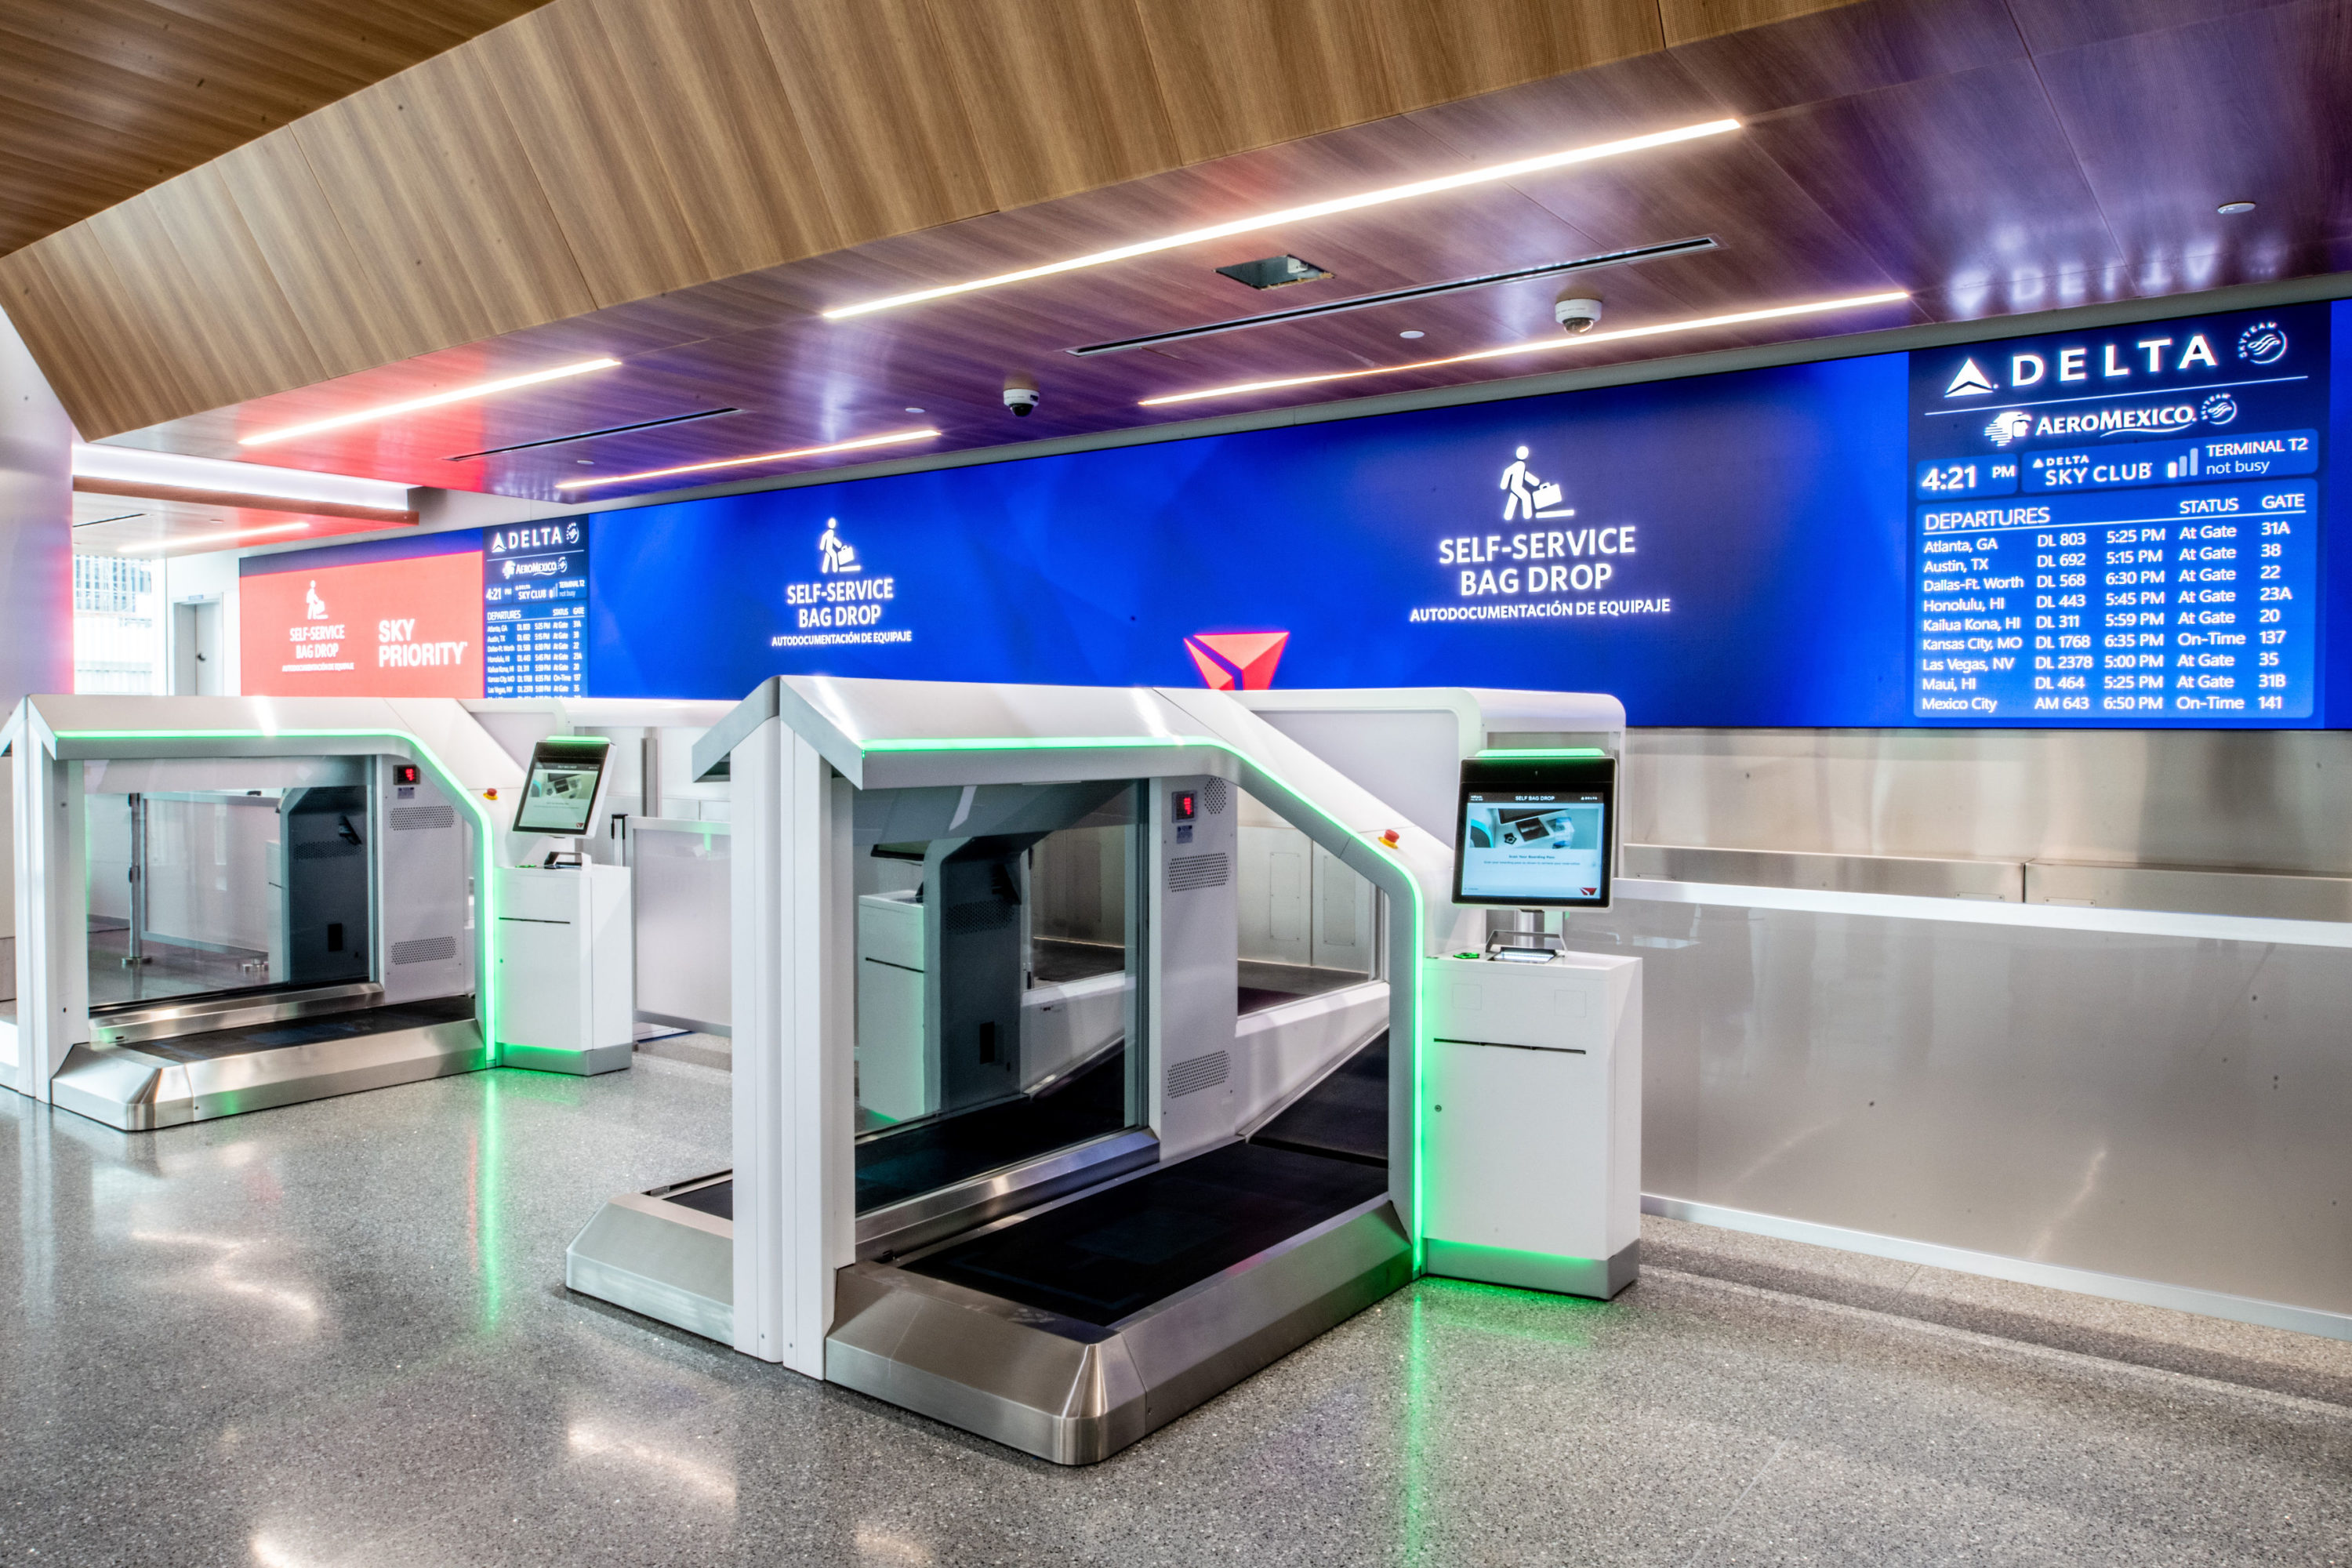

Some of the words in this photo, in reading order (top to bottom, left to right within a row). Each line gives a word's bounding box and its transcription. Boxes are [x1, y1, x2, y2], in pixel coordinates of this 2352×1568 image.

[2012, 335, 2217, 387] DELTA
[2206, 440, 2285, 457] TERMINAL
[2288, 437, 2309, 451] T2
[2046, 455, 2089, 466] DELTA
[2207, 463, 2230, 474] not
[2235, 460, 2270, 474] busy
[1922, 465, 1976, 491] 4:21
[1992, 465, 2016, 478] PM
[2045, 467, 2088, 485] SKY
[2093, 463, 2153, 482] CLUB
[1926, 507, 2050, 531] DEPARTURES
[2180, 498, 2239, 514] STATUS
[2262, 493, 2305, 509] GATE
[508, 527, 562, 549] DELTA
[1439, 525, 1635, 564] SELF-SERVICE
[1924, 540, 1973, 554] Atlanta,
[1976, 538, 1998, 550] GA
[2038, 535, 2056, 547] DL
[2060, 532, 2086, 546] 803
[2107, 529, 2137, 543] 5:25
[2142, 528, 2166, 542] PM
[2180, 527, 2197, 539] At
[2200, 525, 2238, 539] Gate
[2261, 521, 2291, 535] 31A
[1923, 560, 1967, 573] Austin,
[1971, 558, 1989, 571] TX
[2037, 555, 2056, 568] DL
[2060, 553, 2086, 566] 692
[2107, 550, 2134, 564] 5:15
[2139, 550, 2163, 563] PM
[2179, 548, 2197, 561] At
[2200, 546, 2237, 560] Gate
[2261, 543, 2281, 557] 38
[1461, 568, 1519, 596] BAG
[1528, 563, 1613, 593] DROP
[1924, 578, 1980, 592] Dallas-Ft.
[1983, 576, 2024, 590] Worth
[2037, 575, 2056, 588] DL
[2060, 573, 2086, 587] 568
[2106, 572, 2137, 585] 6:30
[2141, 570, 2165, 583] PM
[2179, 569, 2196, 582] At
[2199, 568, 2237, 581] Gate
[2260, 565, 2281, 579] 22
[486, 588, 501, 601] 4:21
[518, 590, 530, 600] SKY
[531, 590, 546, 598] CLUB
[787, 578, 893, 604] SELF-SERVICE
[1924, 597, 1986, 612] Honolulu,
[1990, 597, 2005, 610] HI
[2037, 595, 2056, 608] DL
[2059, 594, 2086, 607] 443
[2106, 592, 2137, 606] 5:45
[2141, 591, 2165, 604] PM
[2178, 590, 2196, 604] At
[2199, 590, 2236, 603] Gate
[2260, 586, 2293, 601] 23A
[488, 610, 521, 620] DEPARTURES
[799, 608, 832, 628] BAG
[836, 604, 881, 626] DROP
[1410, 601, 1573, 622] AUTODOCUMENTACIÓN
[1576, 601, 1595, 615] DE
[1600, 598, 1671, 616] EQUIPAJE
[1923, 619, 1962, 632] Kailua
[1964, 619, 2002, 632] Kona,
[2005, 617, 2021, 630] HI
[2036, 615, 2056, 629] DL
[2059, 615, 2080, 628] 311
[2105, 613, 2137, 627] 5:59
[2140, 612, 2165, 626] PM
[2178, 612, 2196, 624] At
[2198, 611, 2236, 624] Gate
[2259, 608, 2281, 622] 20
[290, 625, 345, 641] SELF-SERVICE
[379, 619, 415, 642] SKY
[771, 631, 860, 646] AUTODOCUMENTACIÓN
[861, 633, 873, 643] DE
[873, 631, 912, 644] EQUIPAJE
[1922, 639, 1965, 651] Kansas
[1967, 637, 1994, 652] City,
[1997, 637, 2023, 649] MO
[2035, 636, 2055, 649] DL
[2059, 635, 2091, 648] 1768
[2104, 633, 2136, 648] 6:35
[2140, 633, 2165, 646] PM
[2177, 632, 2246, 646] On-Time
[2259, 630, 2287, 644] 137
[296, 644, 314, 659] BAG
[315, 644, 339, 658] DROP
[379, 641, 464, 667] PRIORITY
[1922, 659, 1944, 671] Las
[1947, 658, 1989, 674] Vegas,
[1992, 657, 2016, 670] NV
[2035, 656, 2055, 670] DL
[2058, 655, 2094, 669] 2378
[2104, 655, 2136, 669] 5:00
[2140, 654, 2164, 667] PM
[2176, 654, 2195, 667] At
[2198, 653, 2235, 667] Gate
[2259, 652, 2279, 666] 35
[1922, 677, 1958, 692] Maui,
[1961, 677, 1976, 690] HI
[2034, 676, 2055, 690] DL
[2057, 676, 2085, 690] 464
[2104, 675, 2136, 689] 5:25
[2139, 675, 2164, 688] PM
[2176, 675, 2195, 688] At
[2197, 674, 2235, 688] Gate
[2259, 673, 2287, 688] 31B
[1922, 697, 1969, 710] Mexico
[1971, 697, 1998, 713] City
[2034, 696, 2060, 710] AM
[2062, 696, 2090, 710] 643
[2103, 696, 2136, 710] 6:50
[2139, 696, 2164, 710] PM
[2176, 695, 2245, 710] On-Time
[2258, 695, 2283, 710] 141
